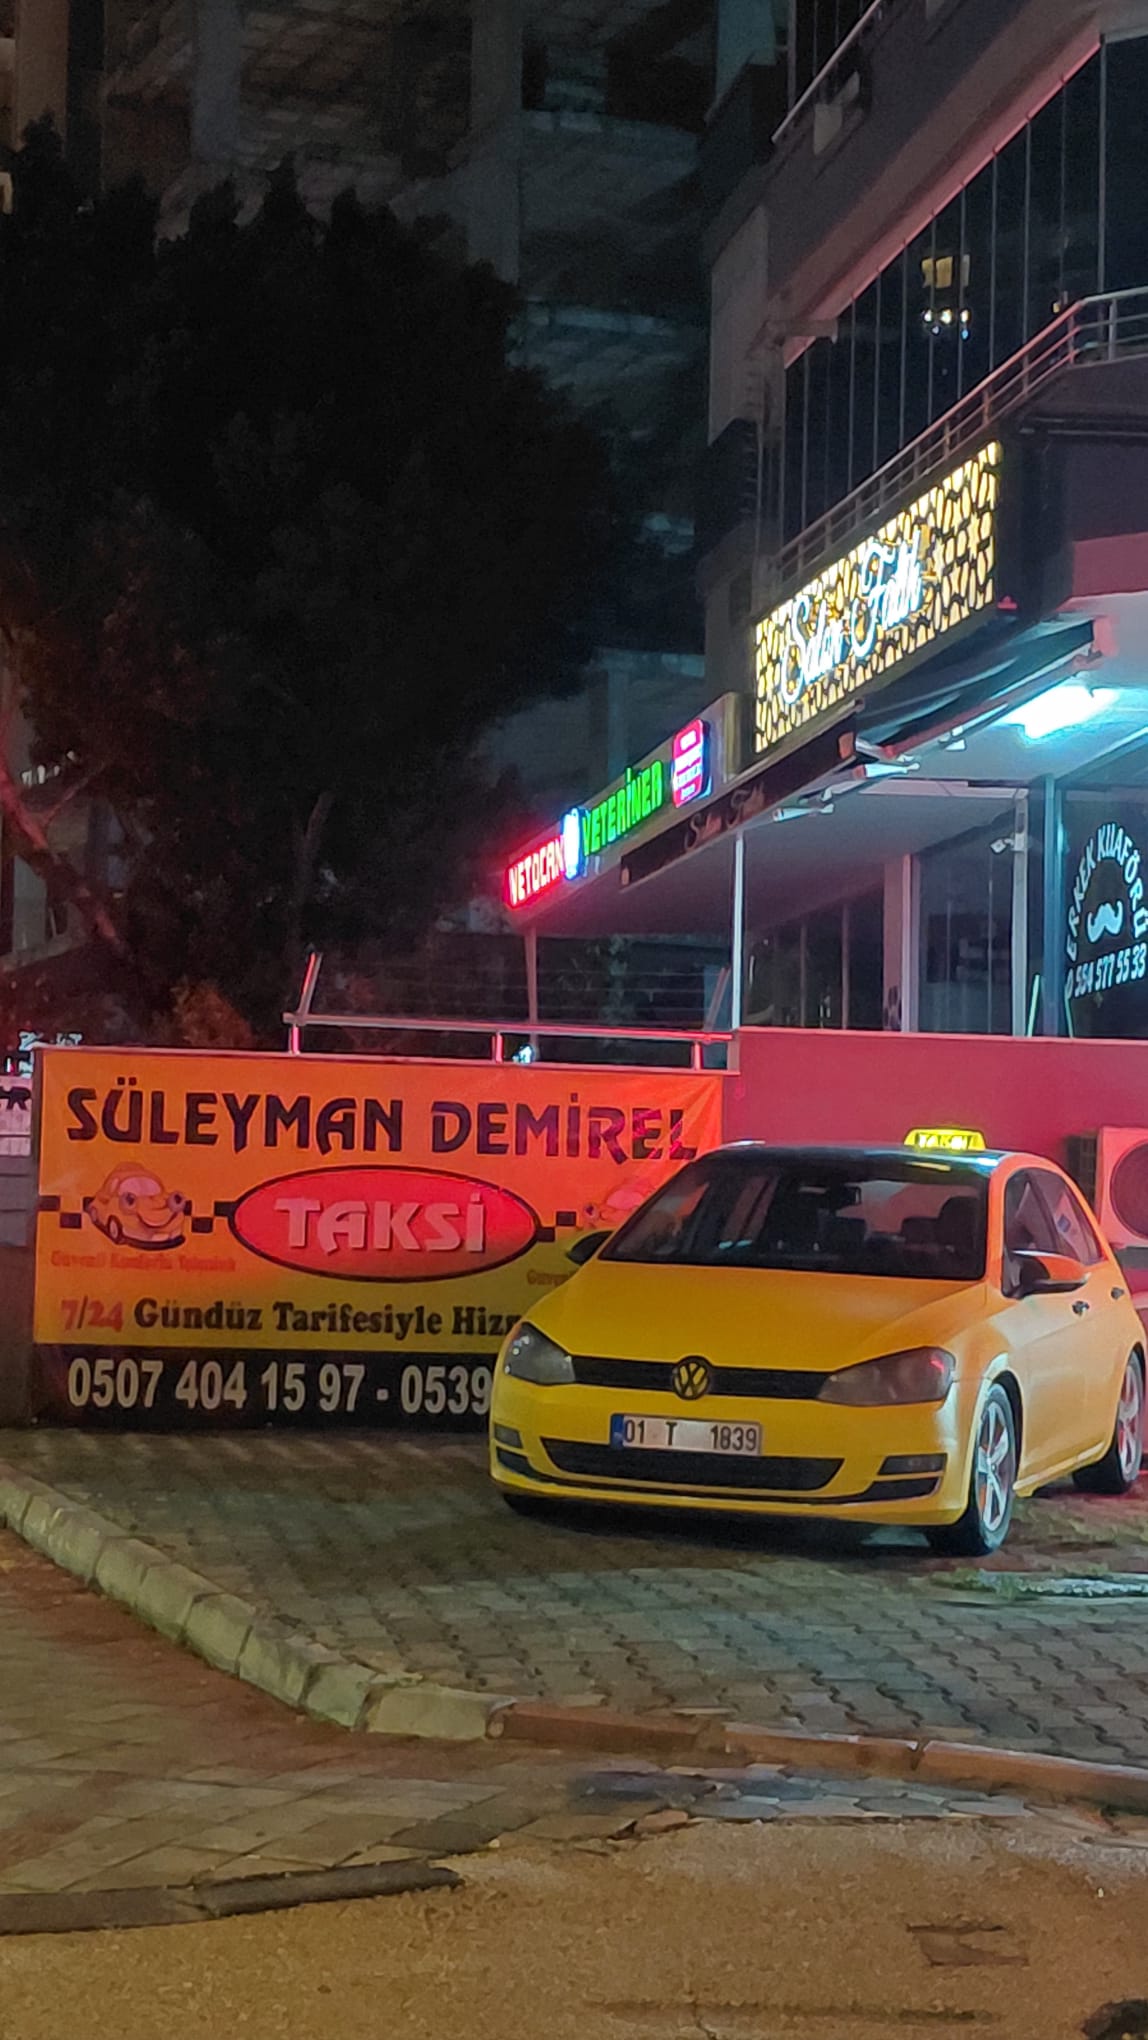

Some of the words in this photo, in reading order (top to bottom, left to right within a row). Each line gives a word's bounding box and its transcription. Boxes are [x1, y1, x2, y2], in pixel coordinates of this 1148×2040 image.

[582, 760, 664, 857] VETERİNER
[1066, 838, 1096, 962] ERKEK
[67, 1076, 403, 1155] SÜLEYMAN
[431, 1093, 698, 1165] DEMİREL
[275, 1192, 487, 1257] TAKSİ
[61, 1295, 124, 1333] 7/24
[134, 1297, 262, 1331] Gündüz
[273, 1301, 441, 1340] Tarifesiyle
[68, 1357, 161, 1409] 0507
[175, 1359, 248, 1410] 404
[260, 1363, 306, 1411] 15
[319, 1363, 366, 1412] 97
[401, 1364, 493, 1415] 0539
[624, 1419, 646, 1445] 01
[665, 1421, 678, 1446] T
[710, 1424, 757, 1452] 1839
